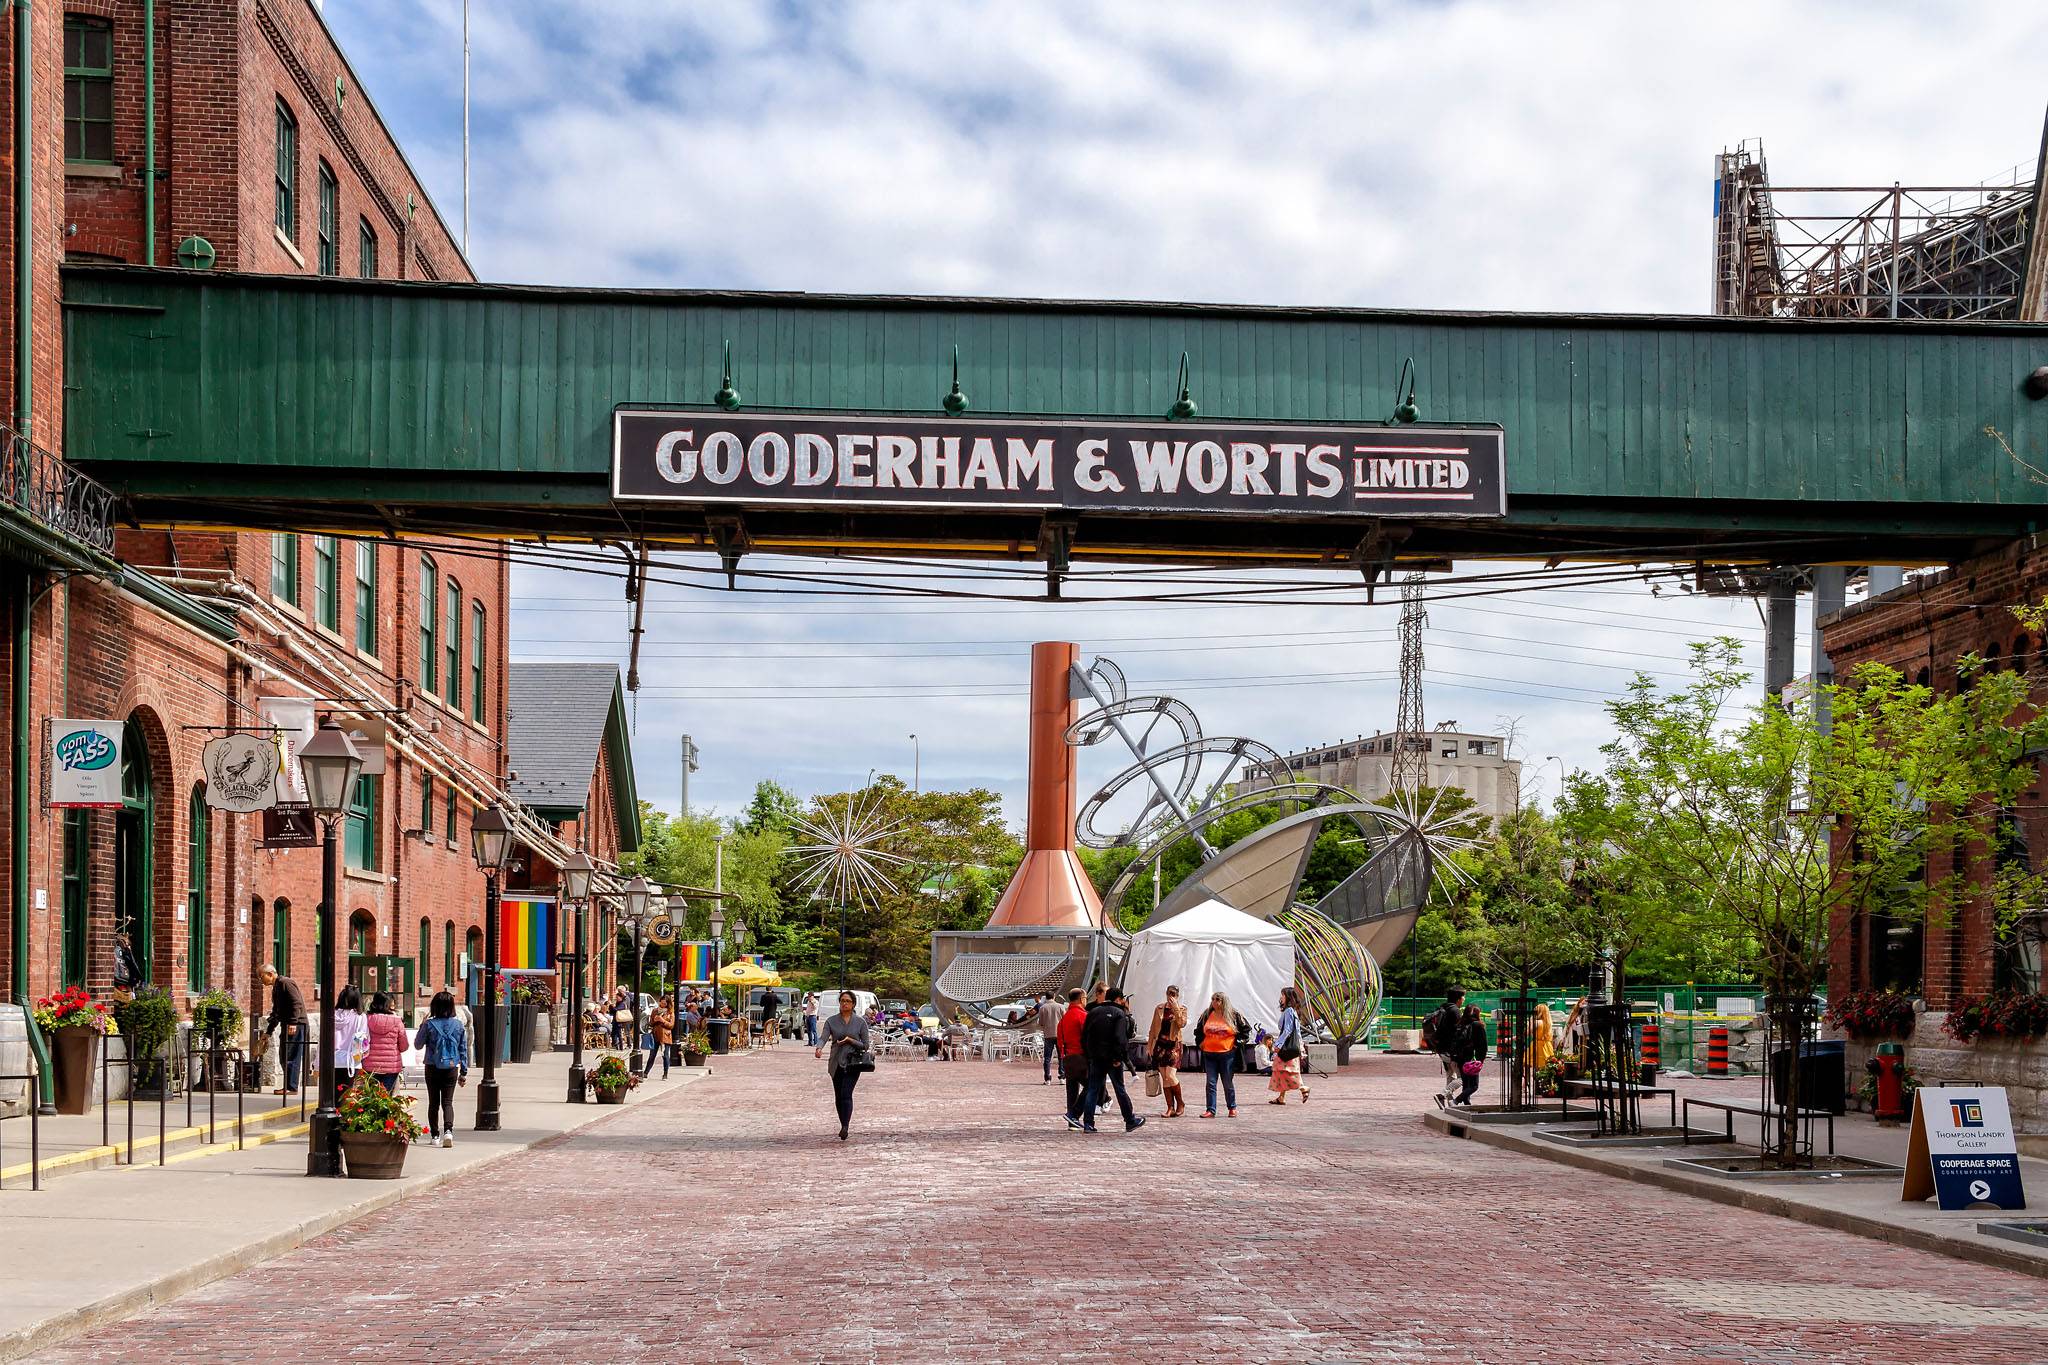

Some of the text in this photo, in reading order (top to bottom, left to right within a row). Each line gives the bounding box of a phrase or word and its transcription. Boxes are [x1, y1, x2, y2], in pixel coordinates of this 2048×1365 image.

[655, 429, 1471, 499] GOODERHAM & WORTS LIMITED
[62, 734, 87, 752] vom
[62, 738, 110, 771] FASS
[287, 740, 295, 788] Dancemakers
[224, 784, 259, 796] BLACKBIRD
[1936, 1131, 2006, 1139] THOMPSON LANDRY
[1957, 1139, 1987, 1148] GALLERY
